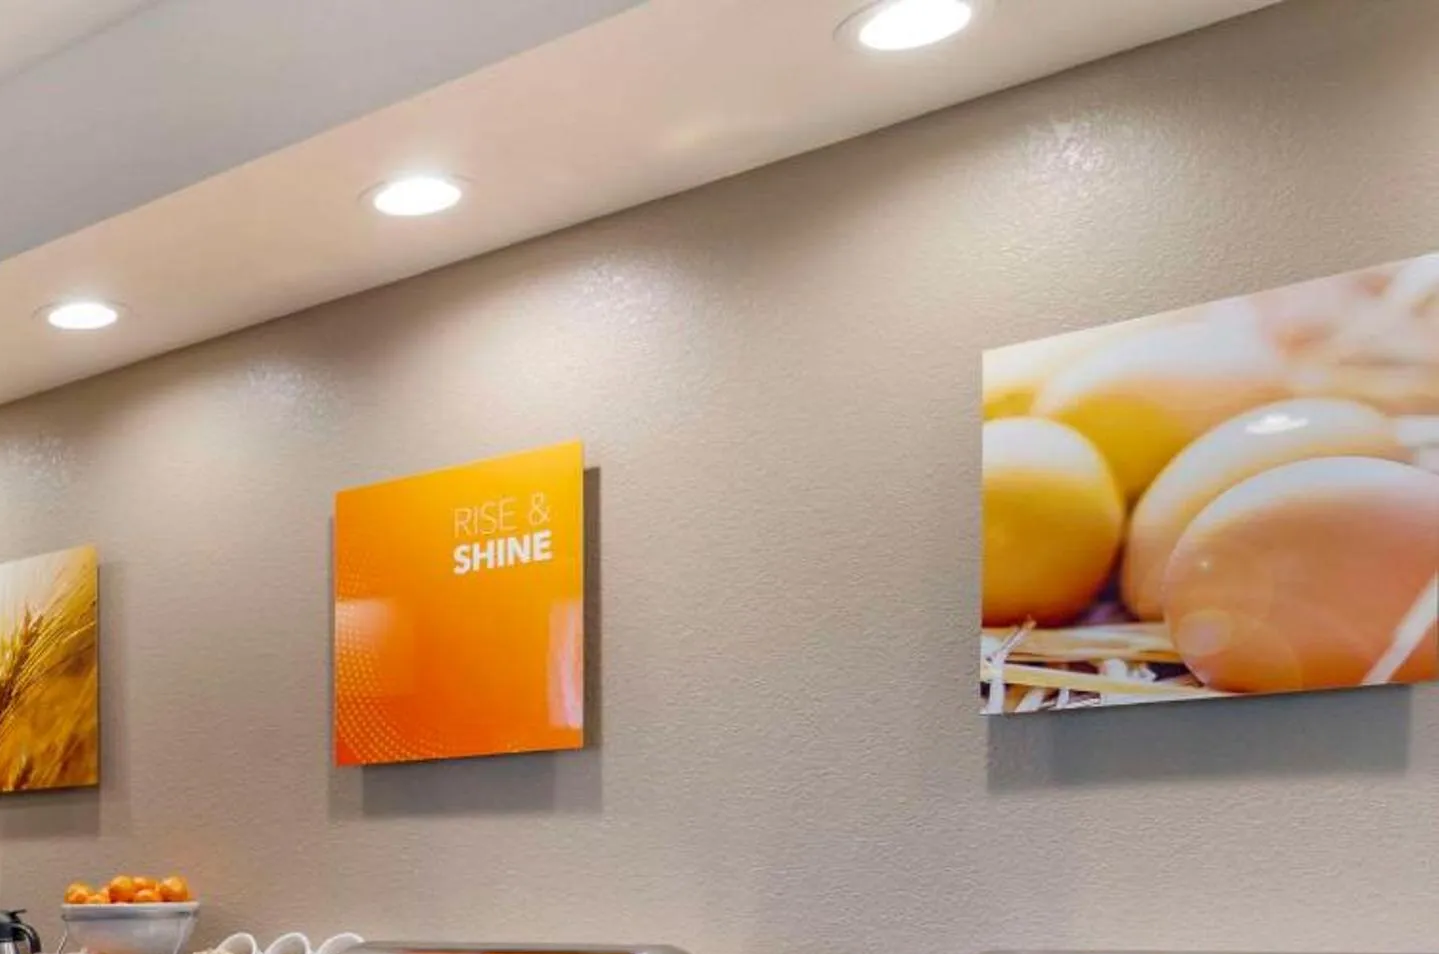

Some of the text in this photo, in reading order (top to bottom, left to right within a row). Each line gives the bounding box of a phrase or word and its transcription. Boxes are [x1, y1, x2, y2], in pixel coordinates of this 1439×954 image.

[453, 492, 550, 538] RISE &
[453, 530, 552, 575] SHINE
